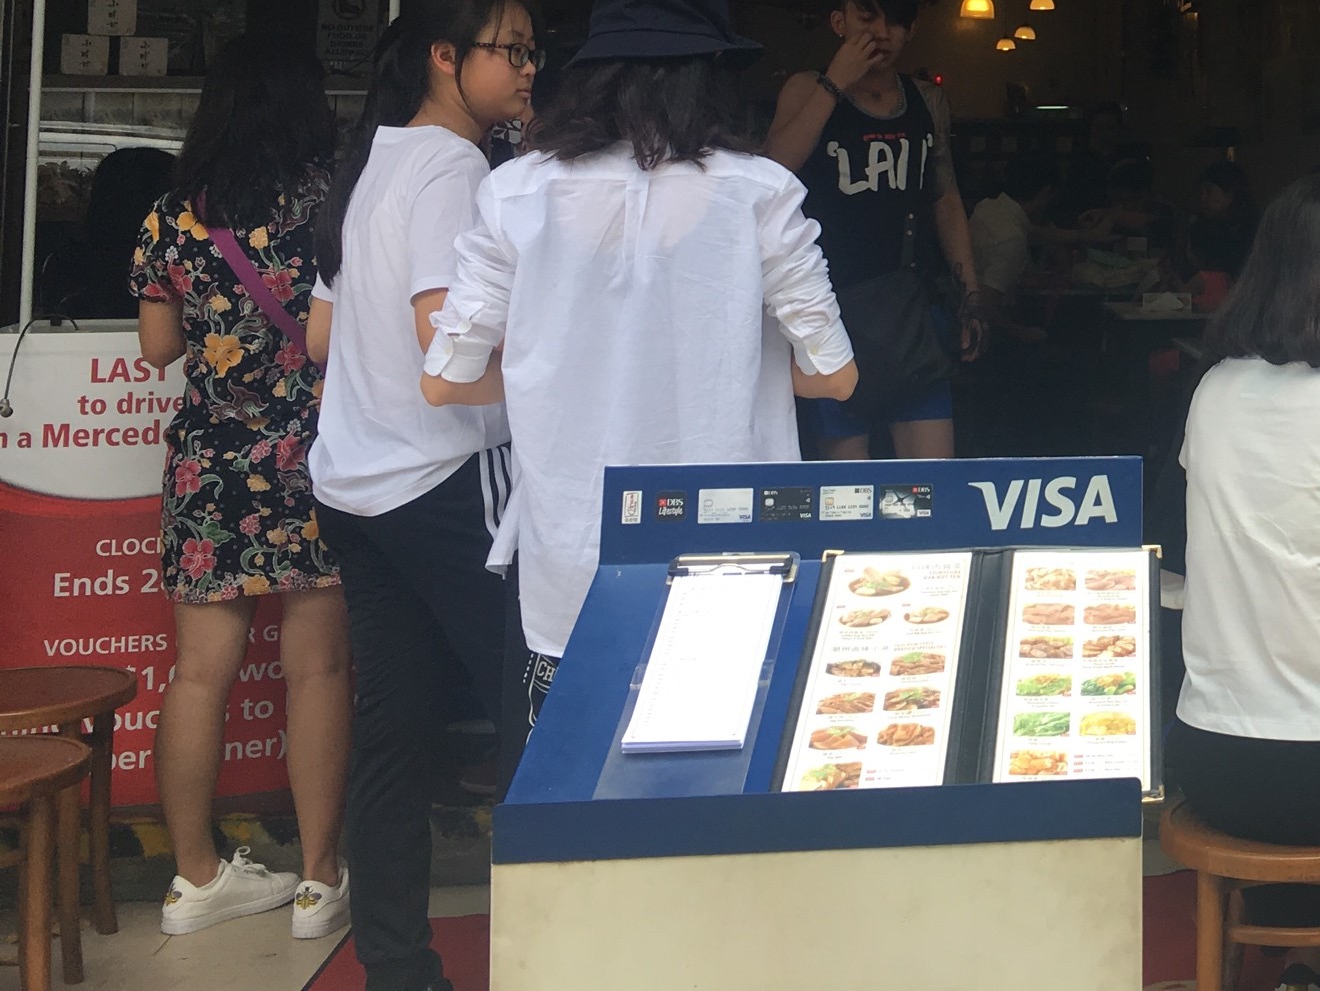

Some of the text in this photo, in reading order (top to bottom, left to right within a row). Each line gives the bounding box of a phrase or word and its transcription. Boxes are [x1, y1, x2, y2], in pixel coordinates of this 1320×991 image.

[78, 391, 185, 416] to drive
[17, 432, 32, 449] a
[667, 498, 684, 506] DBS
[968, 474, 1118, 531] VISA
[54, 568, 165, 597] Ends 2
[44, 634, 168, 657] VOUCHERS
[537, 661, 559, 682] CH
[241, 697, 274, 721] to
